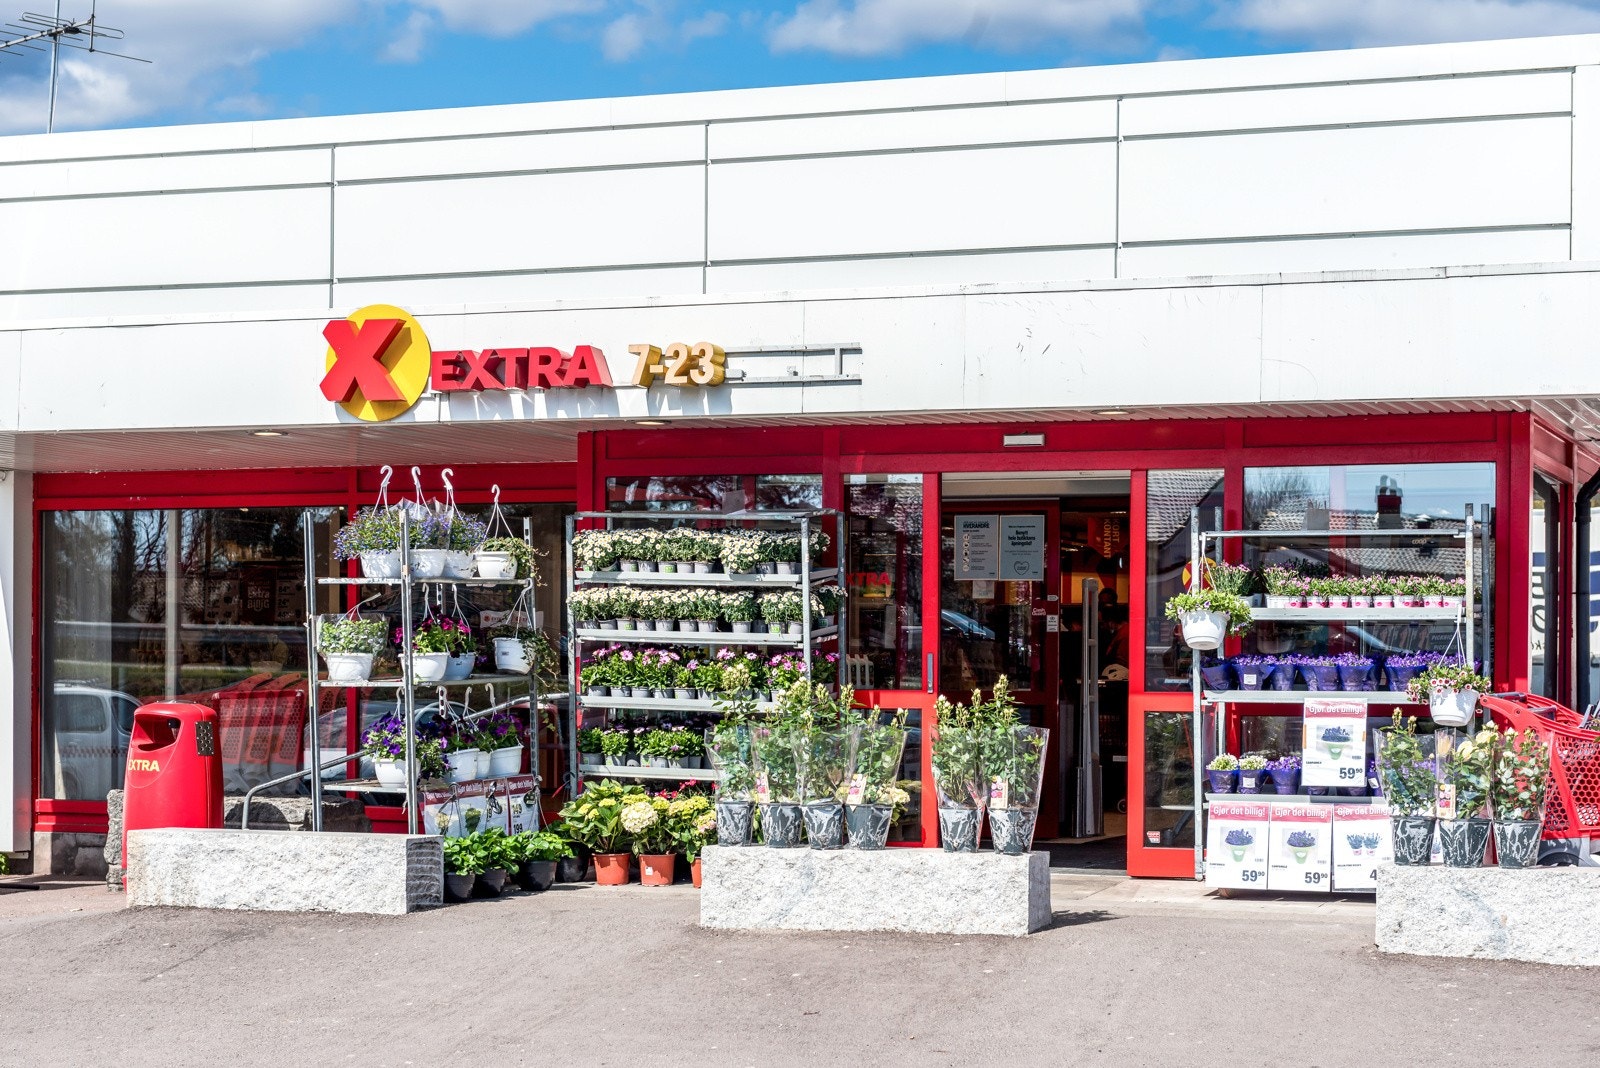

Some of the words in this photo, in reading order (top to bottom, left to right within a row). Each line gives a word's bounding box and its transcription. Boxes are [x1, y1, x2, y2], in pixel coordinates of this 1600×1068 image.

[431, 345, 610, 391] EXTRA
[628, 342, 722, 389] 7-23
[1103, 518, 1112, 559] KONTANT
[846, 571, 891, 587] XTRA
[1213, 806, 1229, 816] Gjør
[1230, 806, 1243, 814] det
[1244, 806, 1265, 817] billig!
[1275, 807, 1291, 817] Gjør
[1292, 807, 1305, 817] det
[1306, 808, 1328, 818] billig!
[1369, 869, 1377, 881] 4
